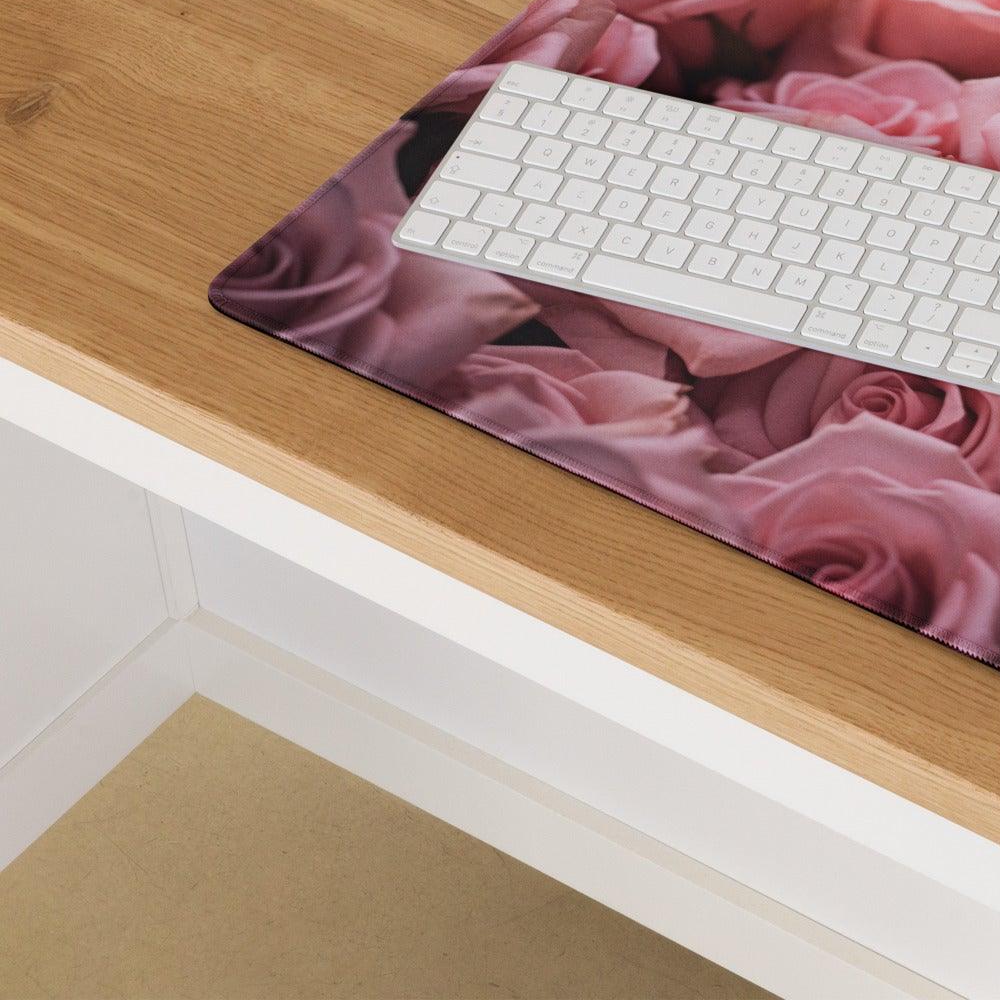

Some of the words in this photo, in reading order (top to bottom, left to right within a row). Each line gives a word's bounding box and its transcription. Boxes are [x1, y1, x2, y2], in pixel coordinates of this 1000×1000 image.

[542, 147, 553, 158] Q
[584, 157, 598, 167] W
[627, 167, 635, 177] E
[669, 178, 680, 187] R
[714, 188, 723, 196] T
[758, 197, 766, 206] Y
[799, 208, 810, 217] U
[886, 229, 897, 238] O
[929, 239, 940, 247] P
[535, 215, 546, 225] Z
[577, 225, 589, 235] X
[621, 235, 632, 245] C
[666, 246, 676, 255] V
[707, 257, 718, 266] B
[751, 267, 762, 277] N
[794, 277, 808, 287] M
[618, 200, 629, 209] D
[662, 210, 671, 218] F
[705, 220, 716, 230] G
[748, 231, 760, 241] H
[791, 242, 801, 250] J
[835, 251, 845, 261] K
[879, 262, 886, 272] L
